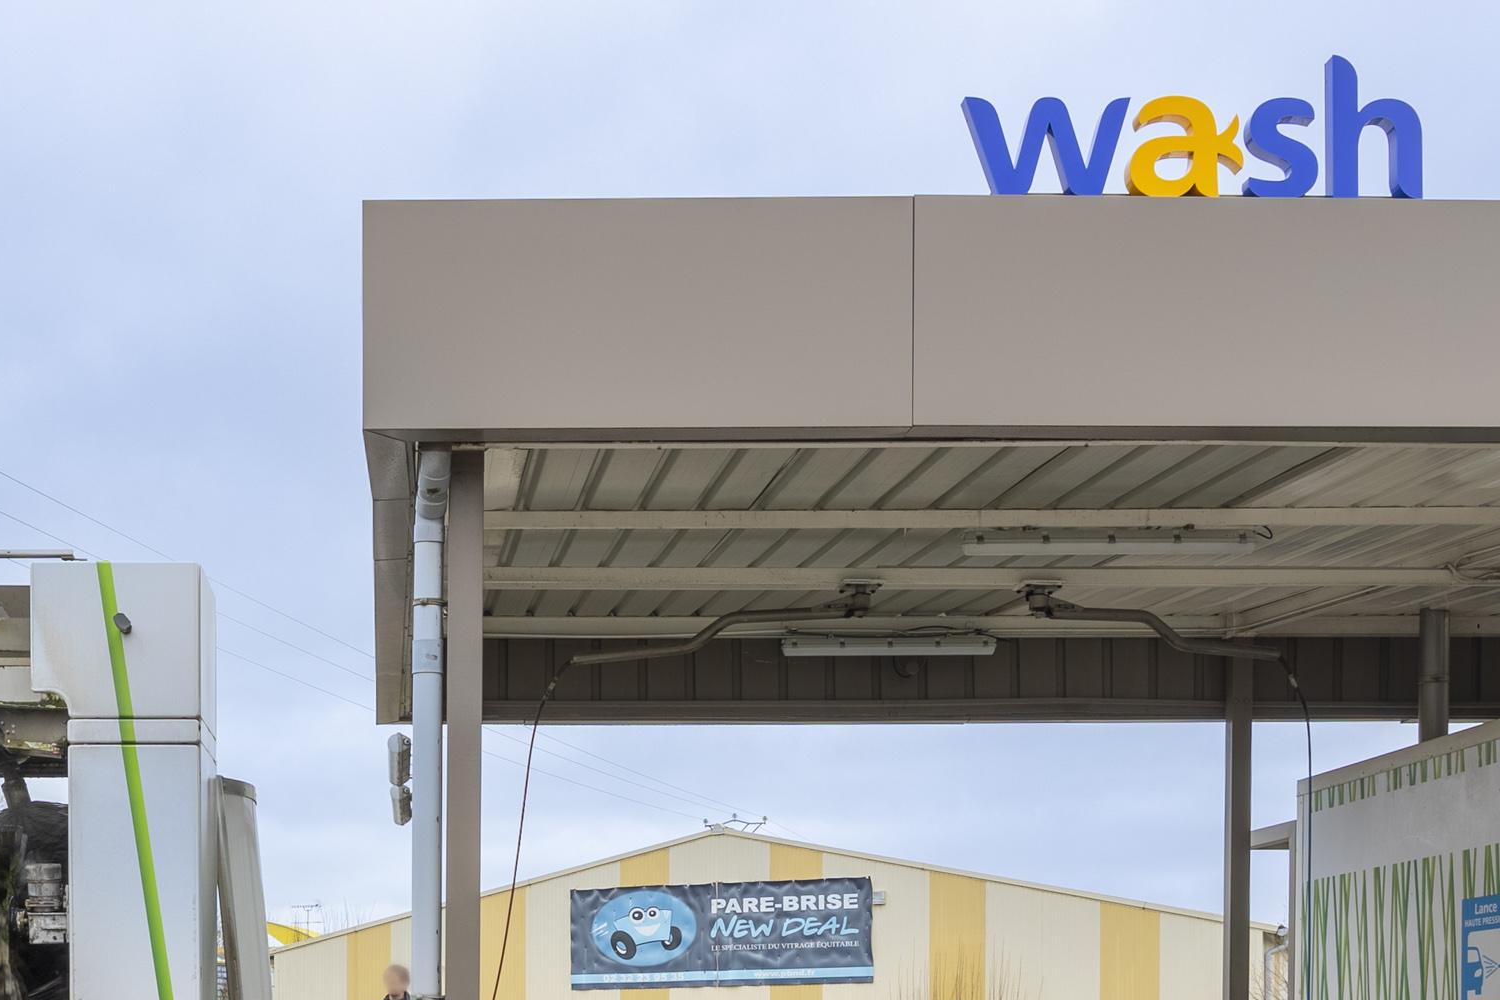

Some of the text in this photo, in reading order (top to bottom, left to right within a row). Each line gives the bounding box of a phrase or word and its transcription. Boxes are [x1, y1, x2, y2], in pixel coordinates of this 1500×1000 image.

[960, 54, 1423, 199] wash
[711, 894, 859, 913] PARE-BRISE
[1475, 903, 1498, 914] Lance
[710, 915, 860, 938] NEW DEAL
[1465, 918, 1482, 927] HAUTE
[721, 942, 767, 951] SPÉCIALISTE
[781, 941, 815, 950] VITRAGE
[816, 940, 860, 949] ÉQUITABLE
[603, 971, 685, 983] 02 32 23 95 35
[753, 969, 816, 979] www.pbnd.fr
